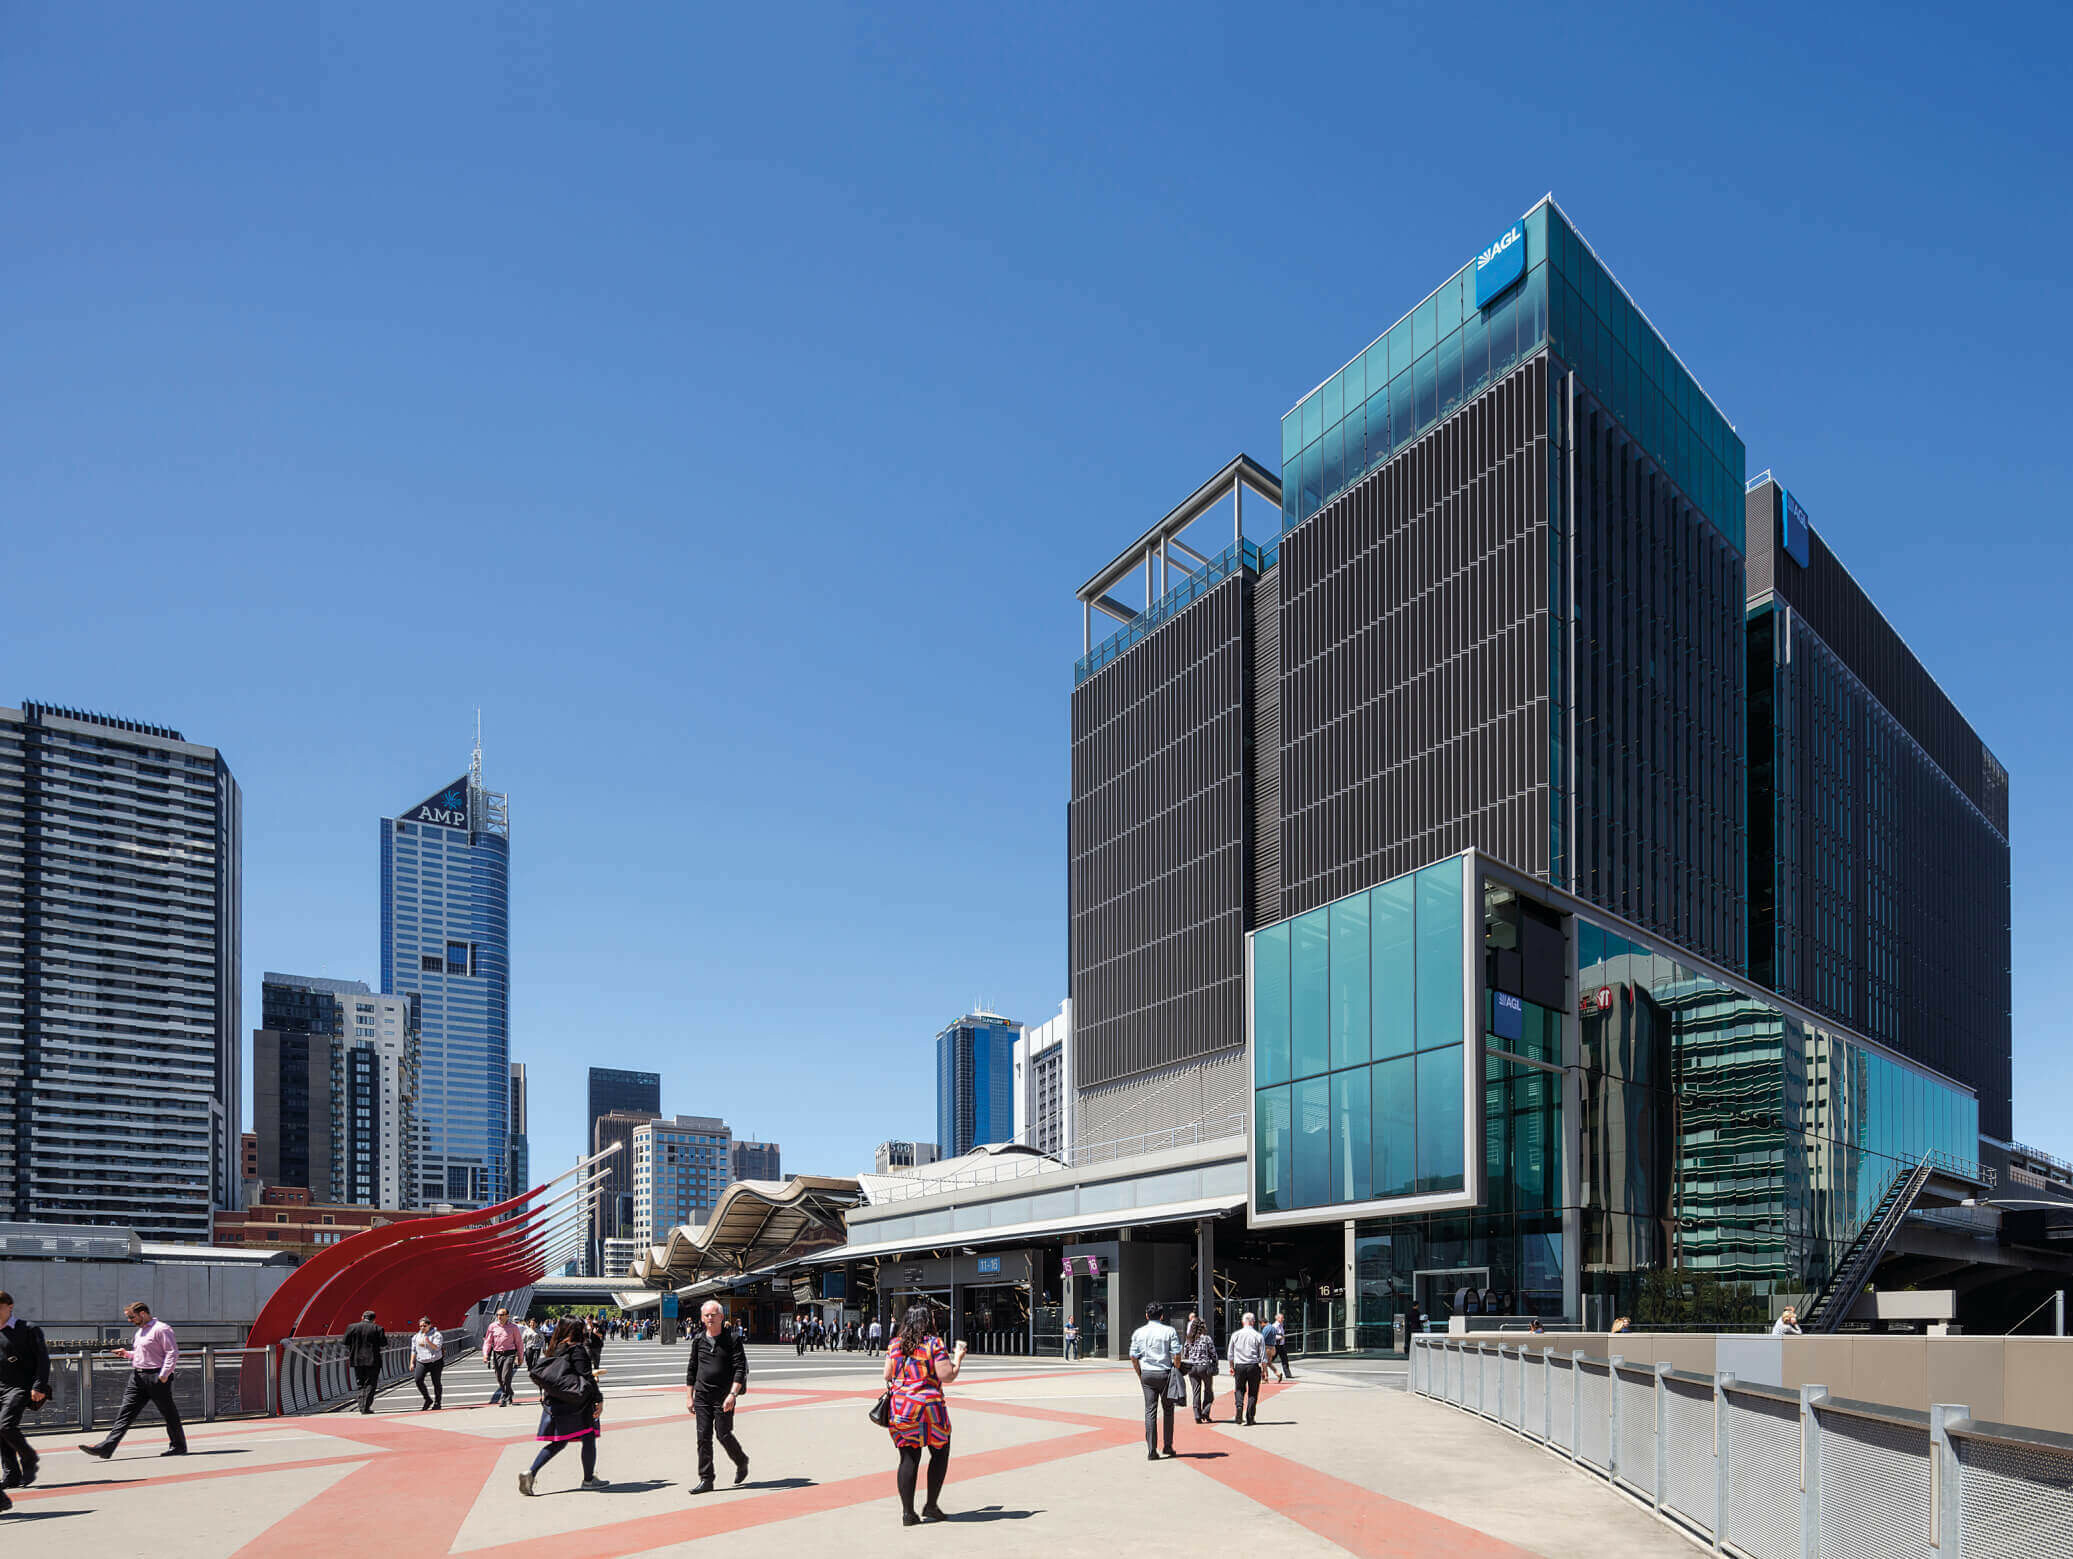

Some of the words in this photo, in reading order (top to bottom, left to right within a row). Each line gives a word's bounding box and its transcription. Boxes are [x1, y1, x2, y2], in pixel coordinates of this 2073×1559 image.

[1490, 227, 1521, 260] AGL
[1793, 503, 1808, 530] AGL
[417, 805, 465, 826] AMP
[1505, 997, 1522, 1012] AGL
[890, 1143, 910, 1153] 500
[1063, 1261, 1072, 1272] 15
[1088, 1259, 1097, 1270] 16
[1319, 1285, 1330, 1296] 16
